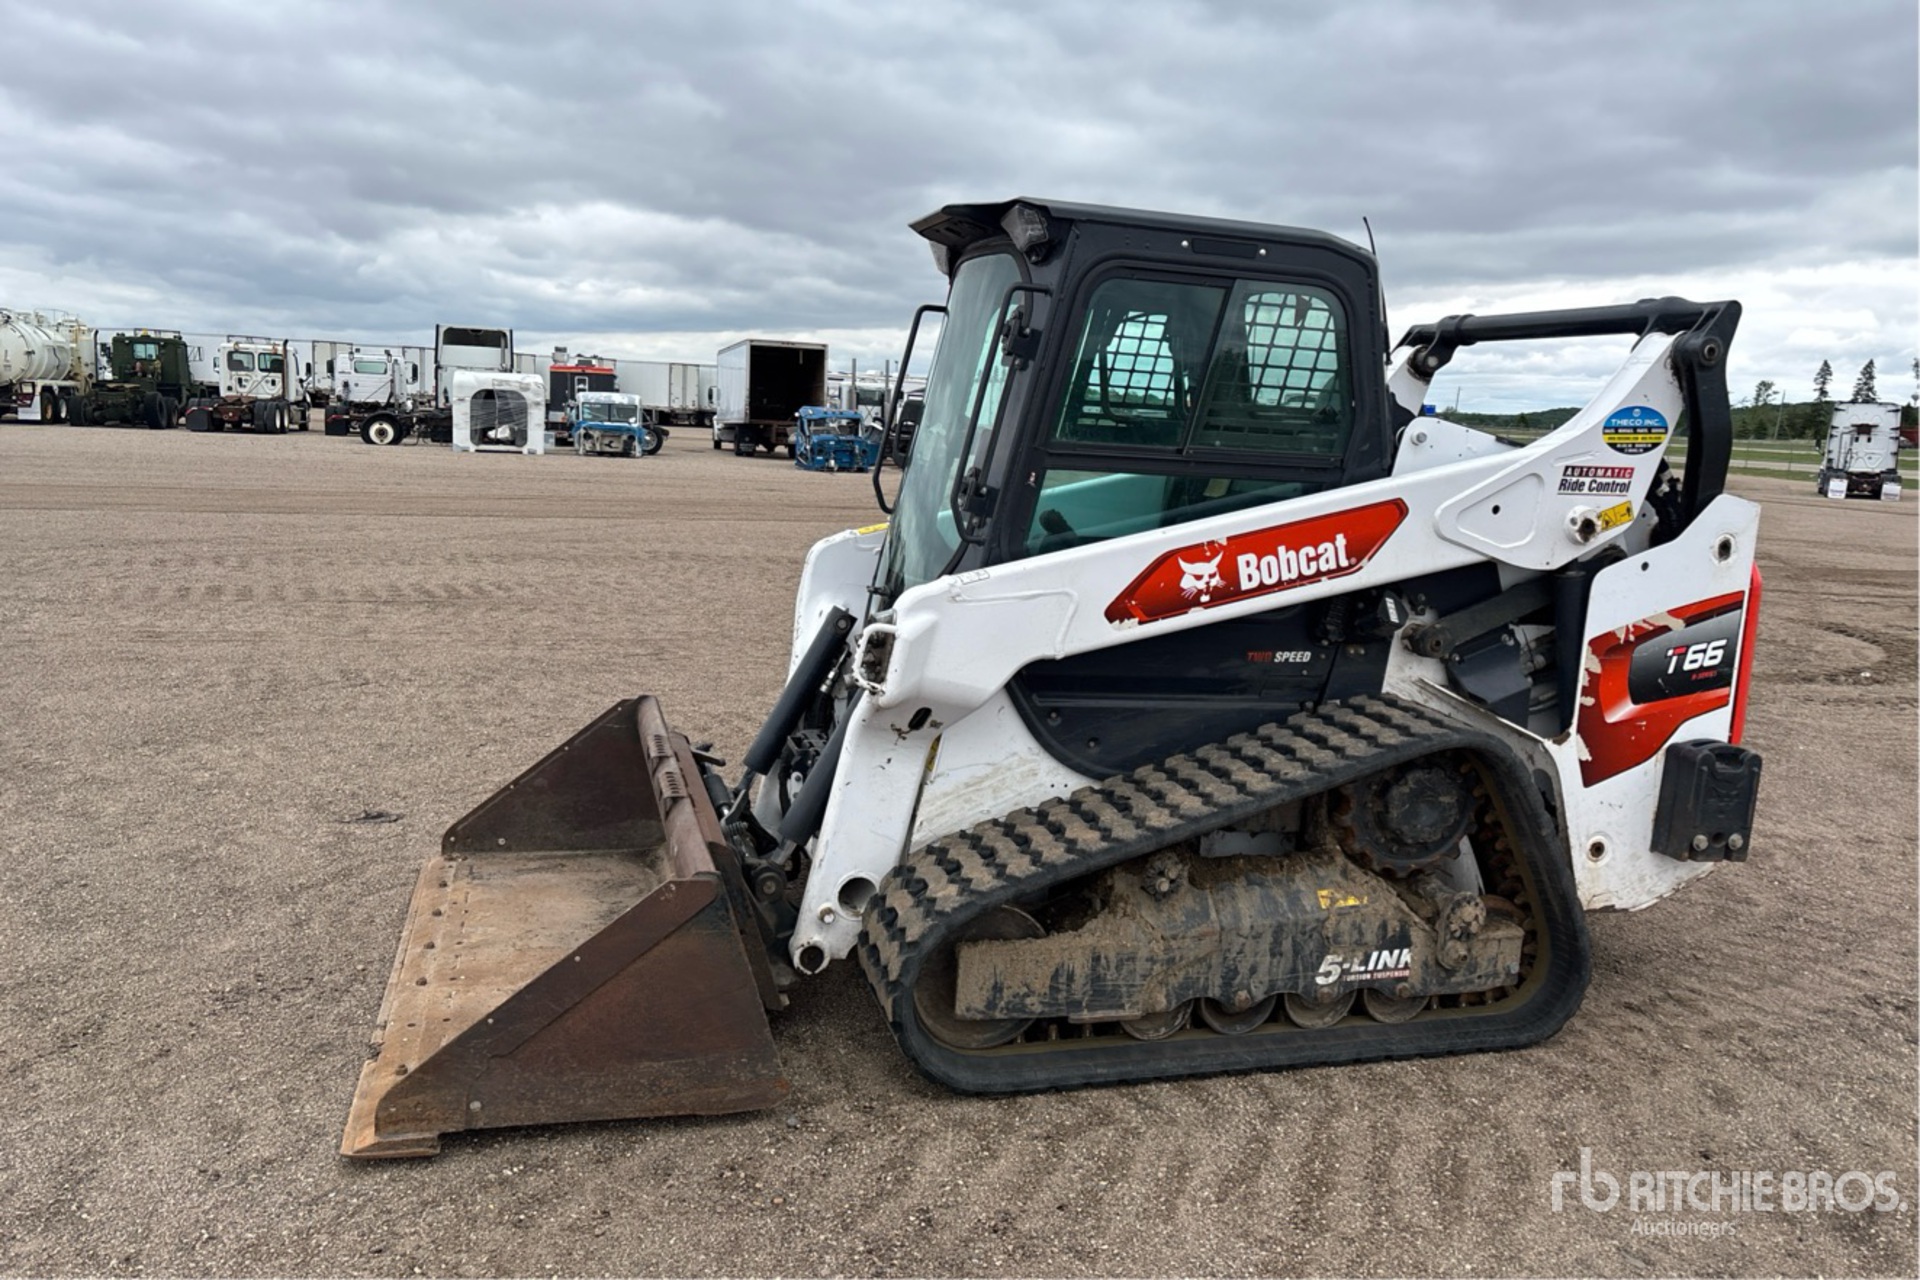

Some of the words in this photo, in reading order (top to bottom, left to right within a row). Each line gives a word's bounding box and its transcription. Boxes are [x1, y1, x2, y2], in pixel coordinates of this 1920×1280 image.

[1565, 467, 1633, 478] AUTOMATIC
[1558, 478, 1586, 492] Ride
[1588, 479, 1632, 493] Control
[1237, 533, 1350, 591] Bobcat
[1274, 651, 1312, 663] SPEED
[1666, 639, 1728, 675] T66
[1315, 948, 1413, 986] 5-LINK
